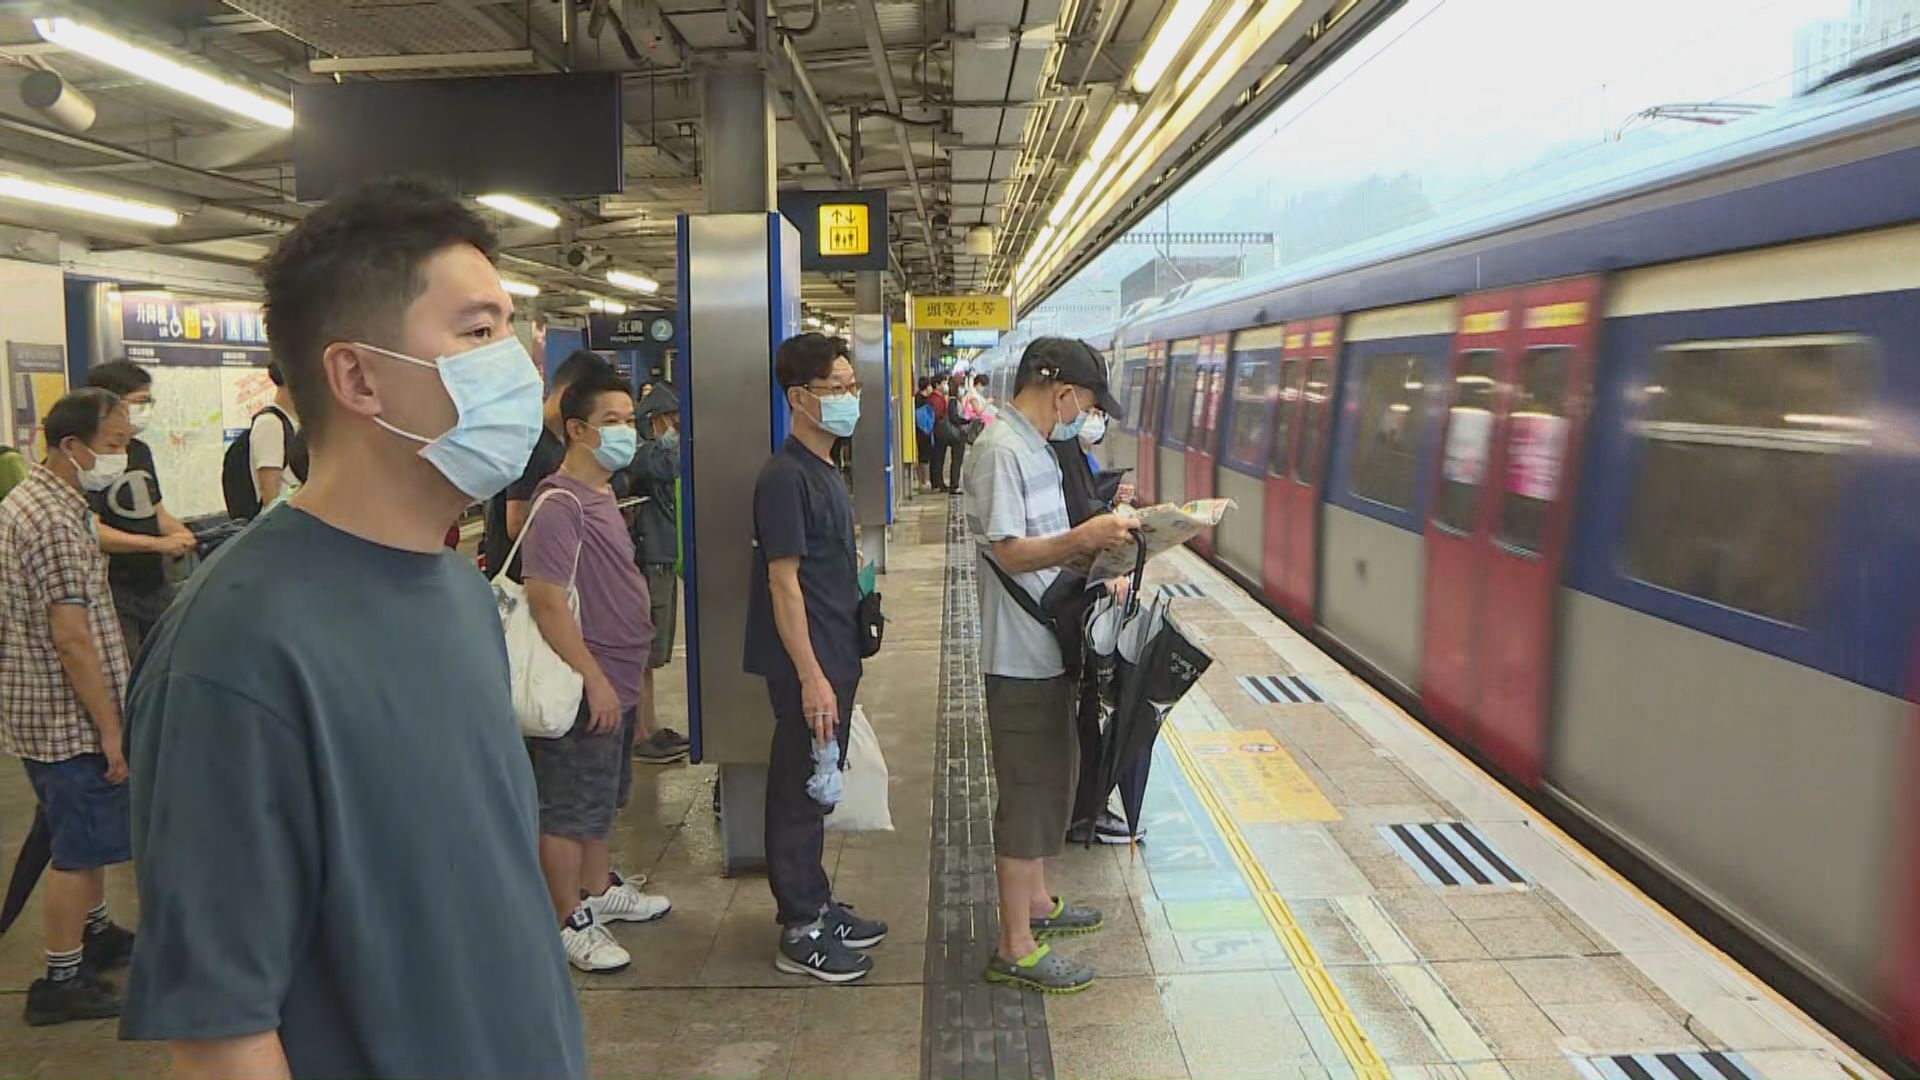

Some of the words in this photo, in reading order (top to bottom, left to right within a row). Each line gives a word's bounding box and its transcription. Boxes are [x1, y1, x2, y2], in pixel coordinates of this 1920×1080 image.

[927, 302, 996, 317] 頭等/头等
[944, 318, 960, 326] First
[961, 318, 980, 327] Class
[834, 924, 852, 937] N
[807, 952, 827, 968] N
